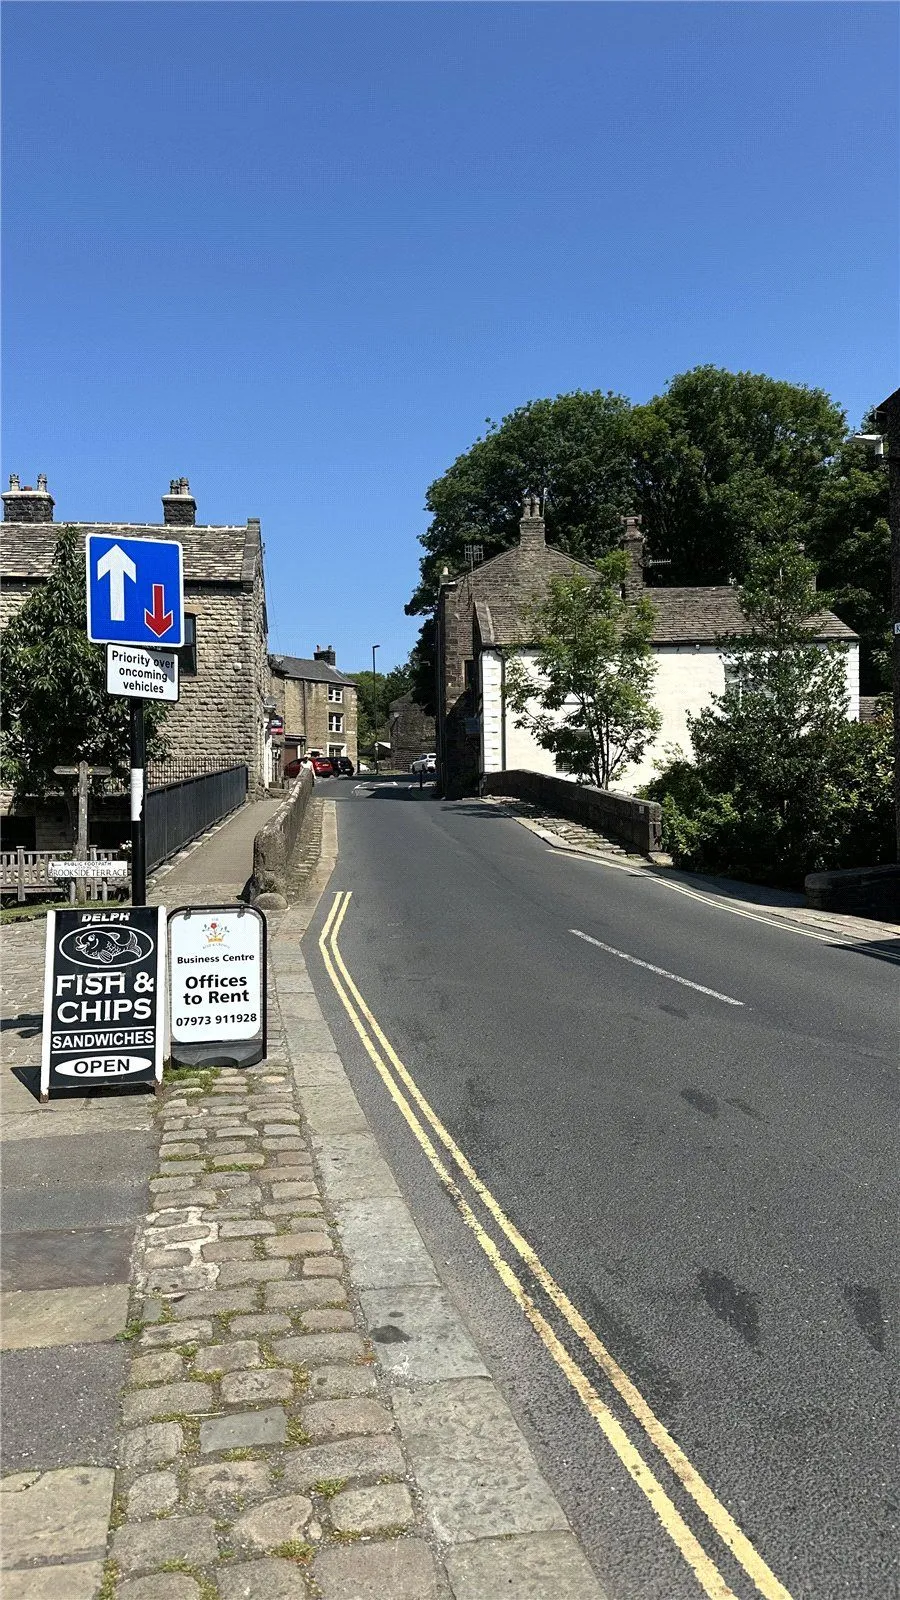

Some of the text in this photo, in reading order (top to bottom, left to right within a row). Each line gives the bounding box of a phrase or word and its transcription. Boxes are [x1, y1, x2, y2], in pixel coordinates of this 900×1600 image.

[112, 650, 174, 668] Priority over
[119, 667, 168, 682] oncoming
[123, 681, 164, 693] vehicles
[92, 868, 127, 877] TERRACE
[81, 912, 130, 922] DELPH
[177, 954, 255, 964] Business Centre
[56, 972, 154, 996] FISH &
[185, 974, 247, 989] Offices
[182, 990, 249, 1005] to Rent
[57, 998, 152, 1023] CHIPS
[176, 1013, 257, 1027] 07973 911928
[52, 1031, 154, 1049] SANDWICHES
[74, 1059, 130, 1074] OPEN
